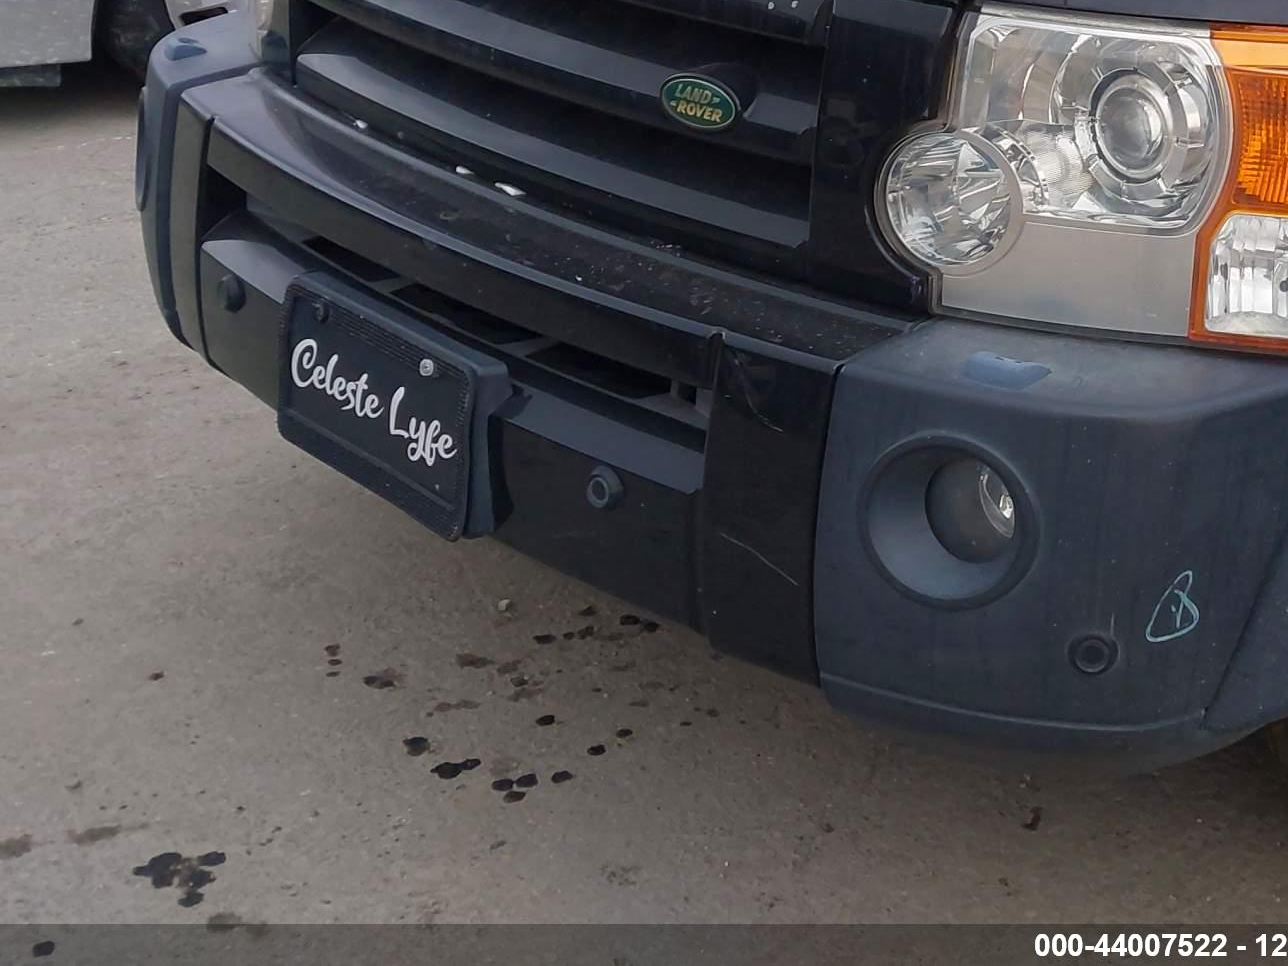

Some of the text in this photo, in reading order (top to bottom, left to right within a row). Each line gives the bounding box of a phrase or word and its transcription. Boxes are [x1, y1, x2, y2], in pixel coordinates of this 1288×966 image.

[674, 83, 712, 104] LAND
[676, 100, 723, 123] ROVER
[291, 338, 458, 467] Celeste Lyfe
